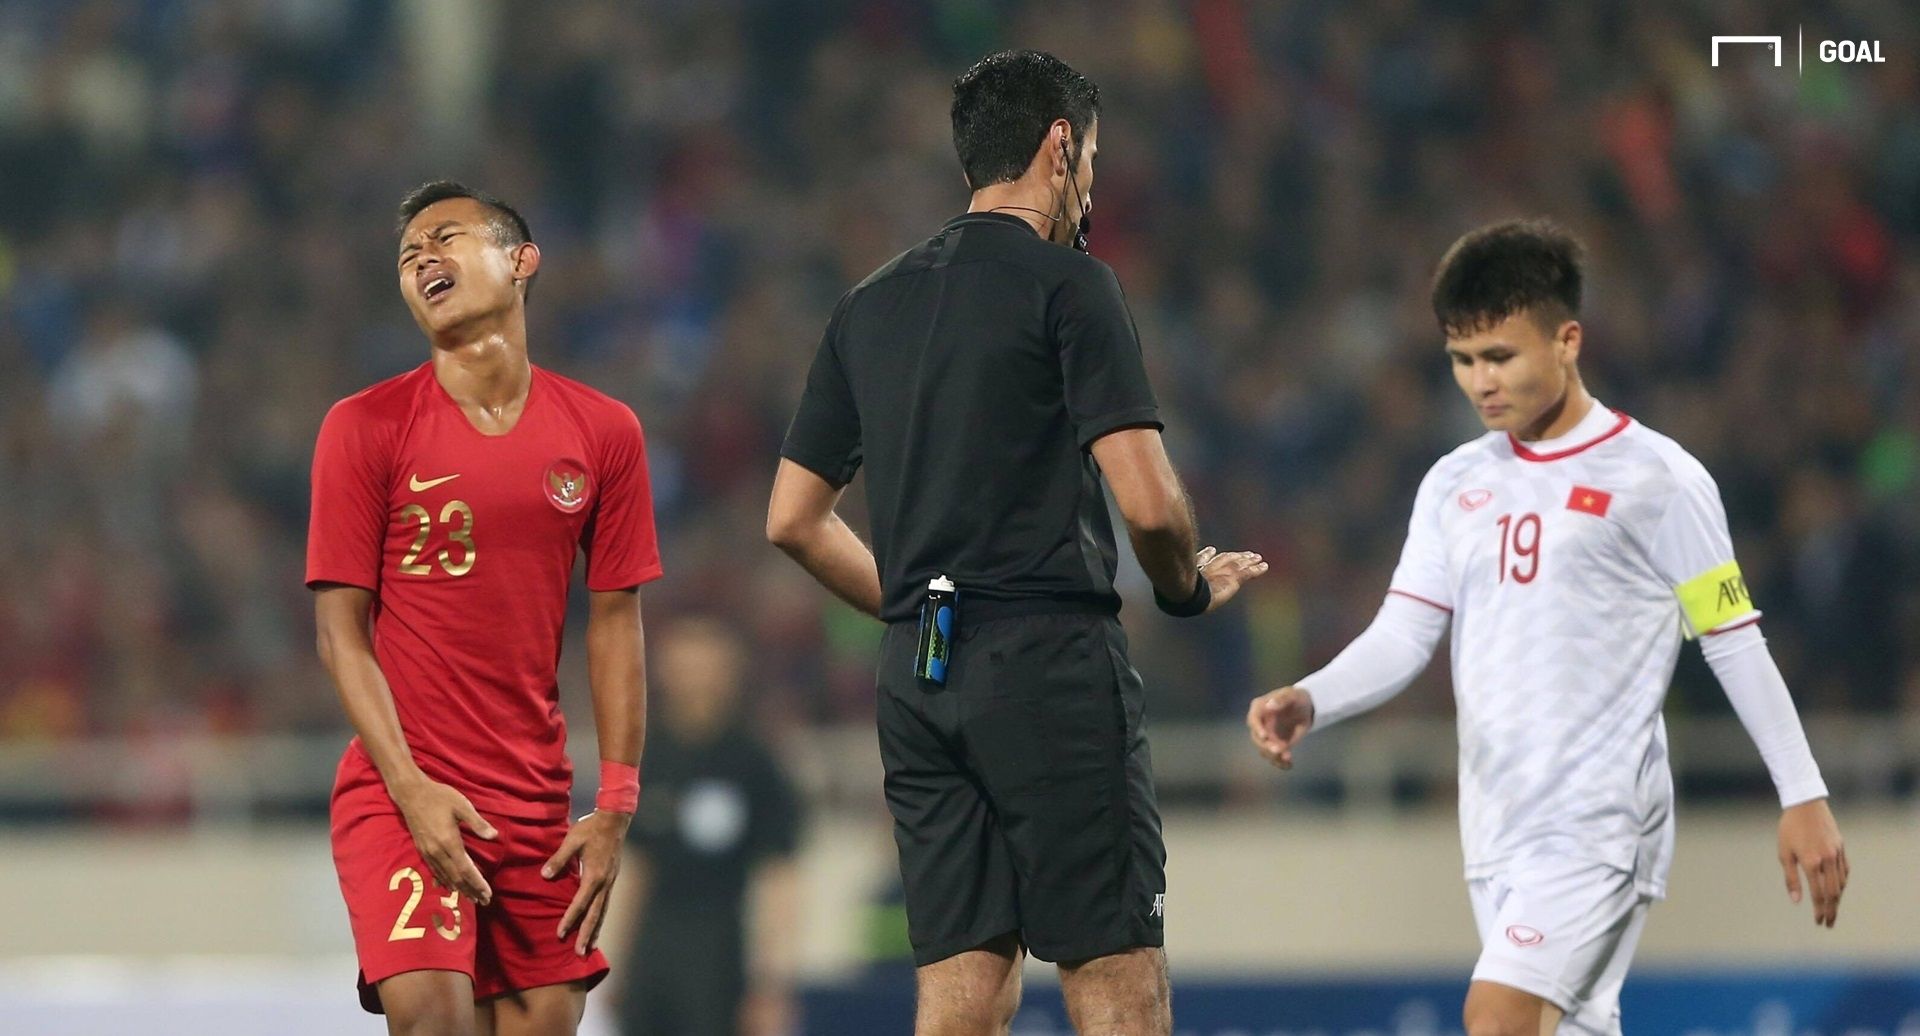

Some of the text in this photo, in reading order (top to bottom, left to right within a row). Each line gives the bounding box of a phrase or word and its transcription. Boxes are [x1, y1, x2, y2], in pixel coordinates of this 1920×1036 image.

[398, 500, 477, 577] 23
[1496, 512, 1542, 585] 19
[1149, 893, 1165, 917] AF
